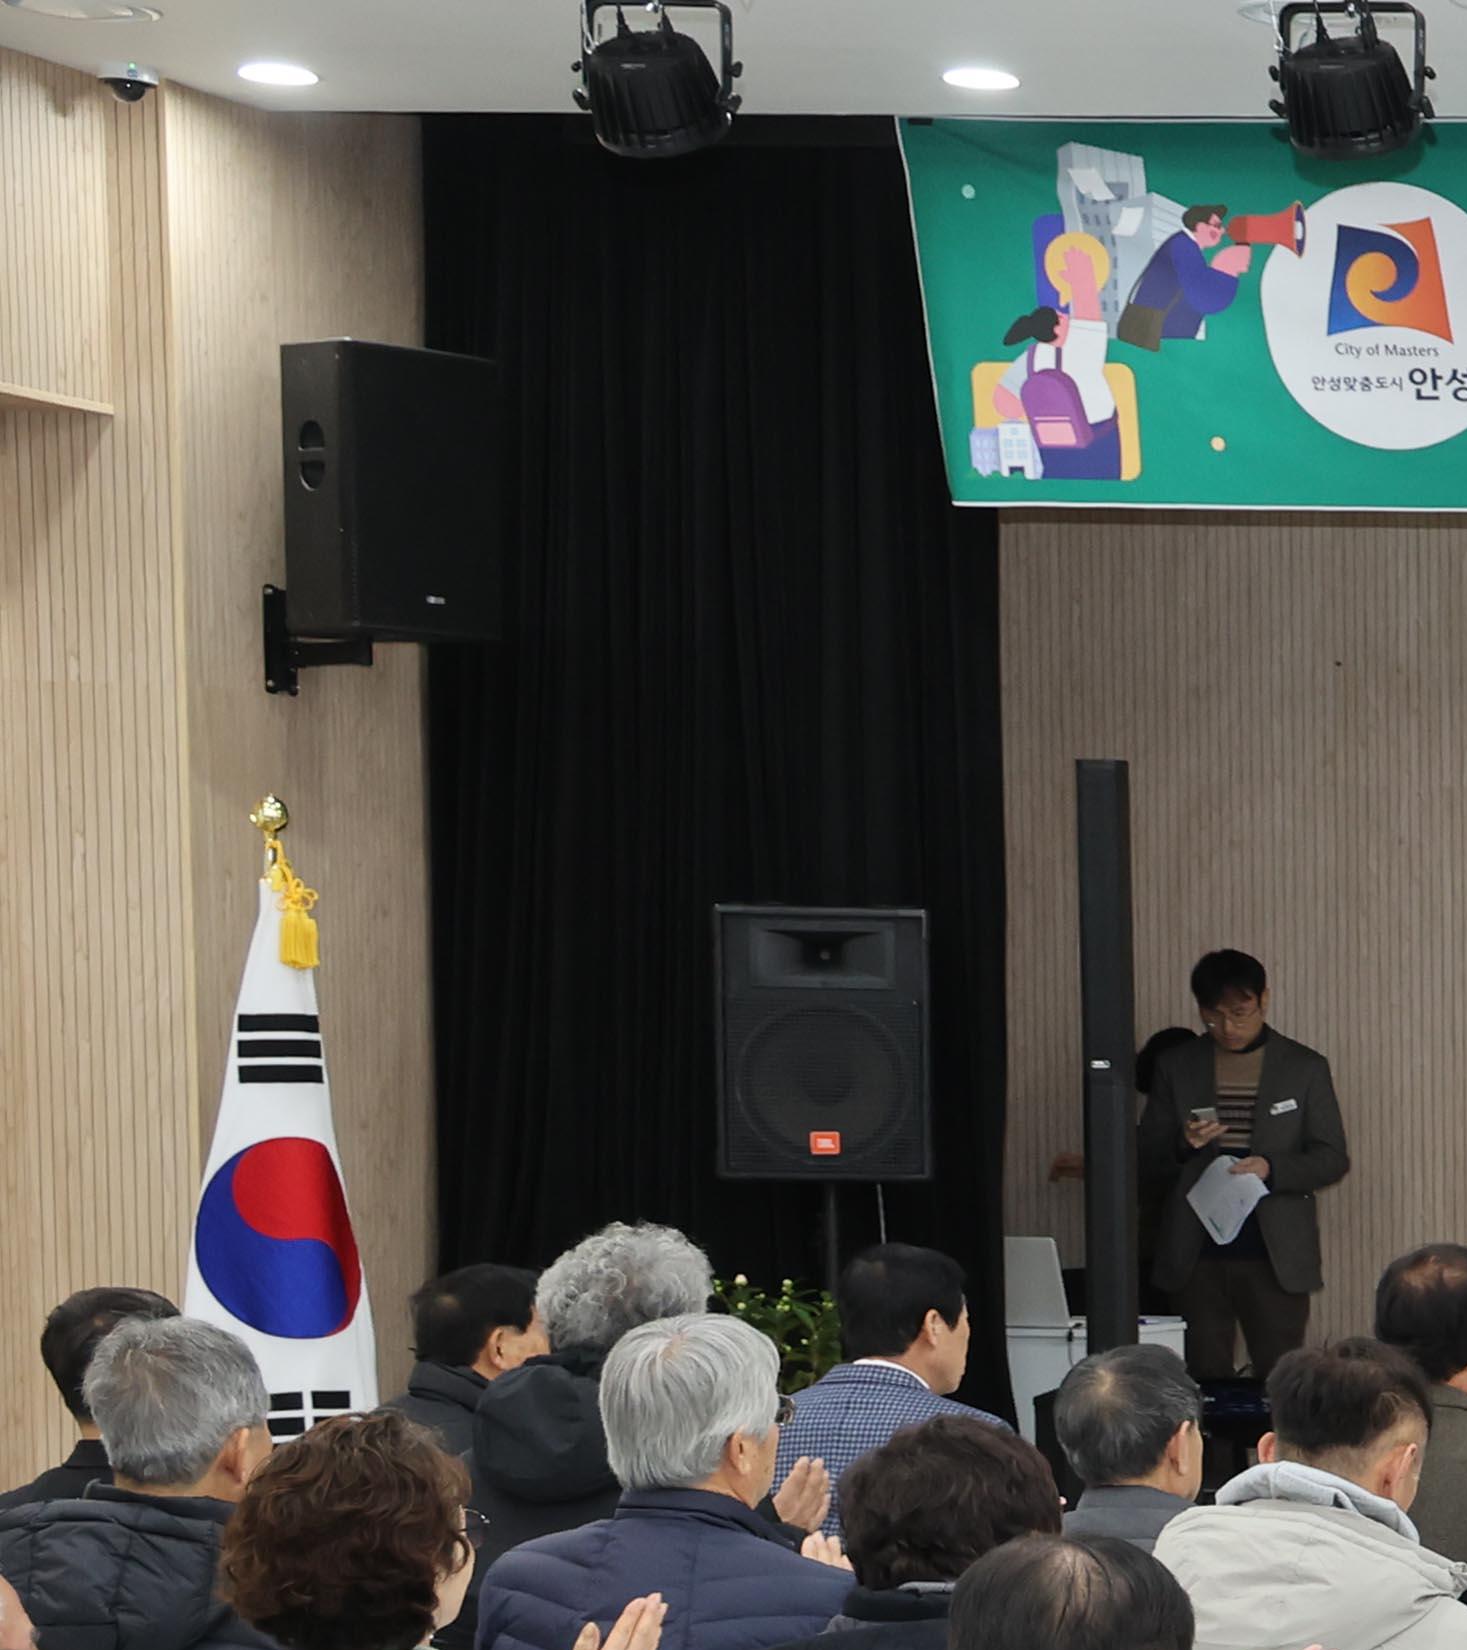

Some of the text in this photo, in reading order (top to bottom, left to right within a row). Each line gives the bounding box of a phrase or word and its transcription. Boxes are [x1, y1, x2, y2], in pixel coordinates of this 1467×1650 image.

[1334, 342, 1440, 359] City of Masters
[1311, 375, 1404, 392] 안성맞춤도시
